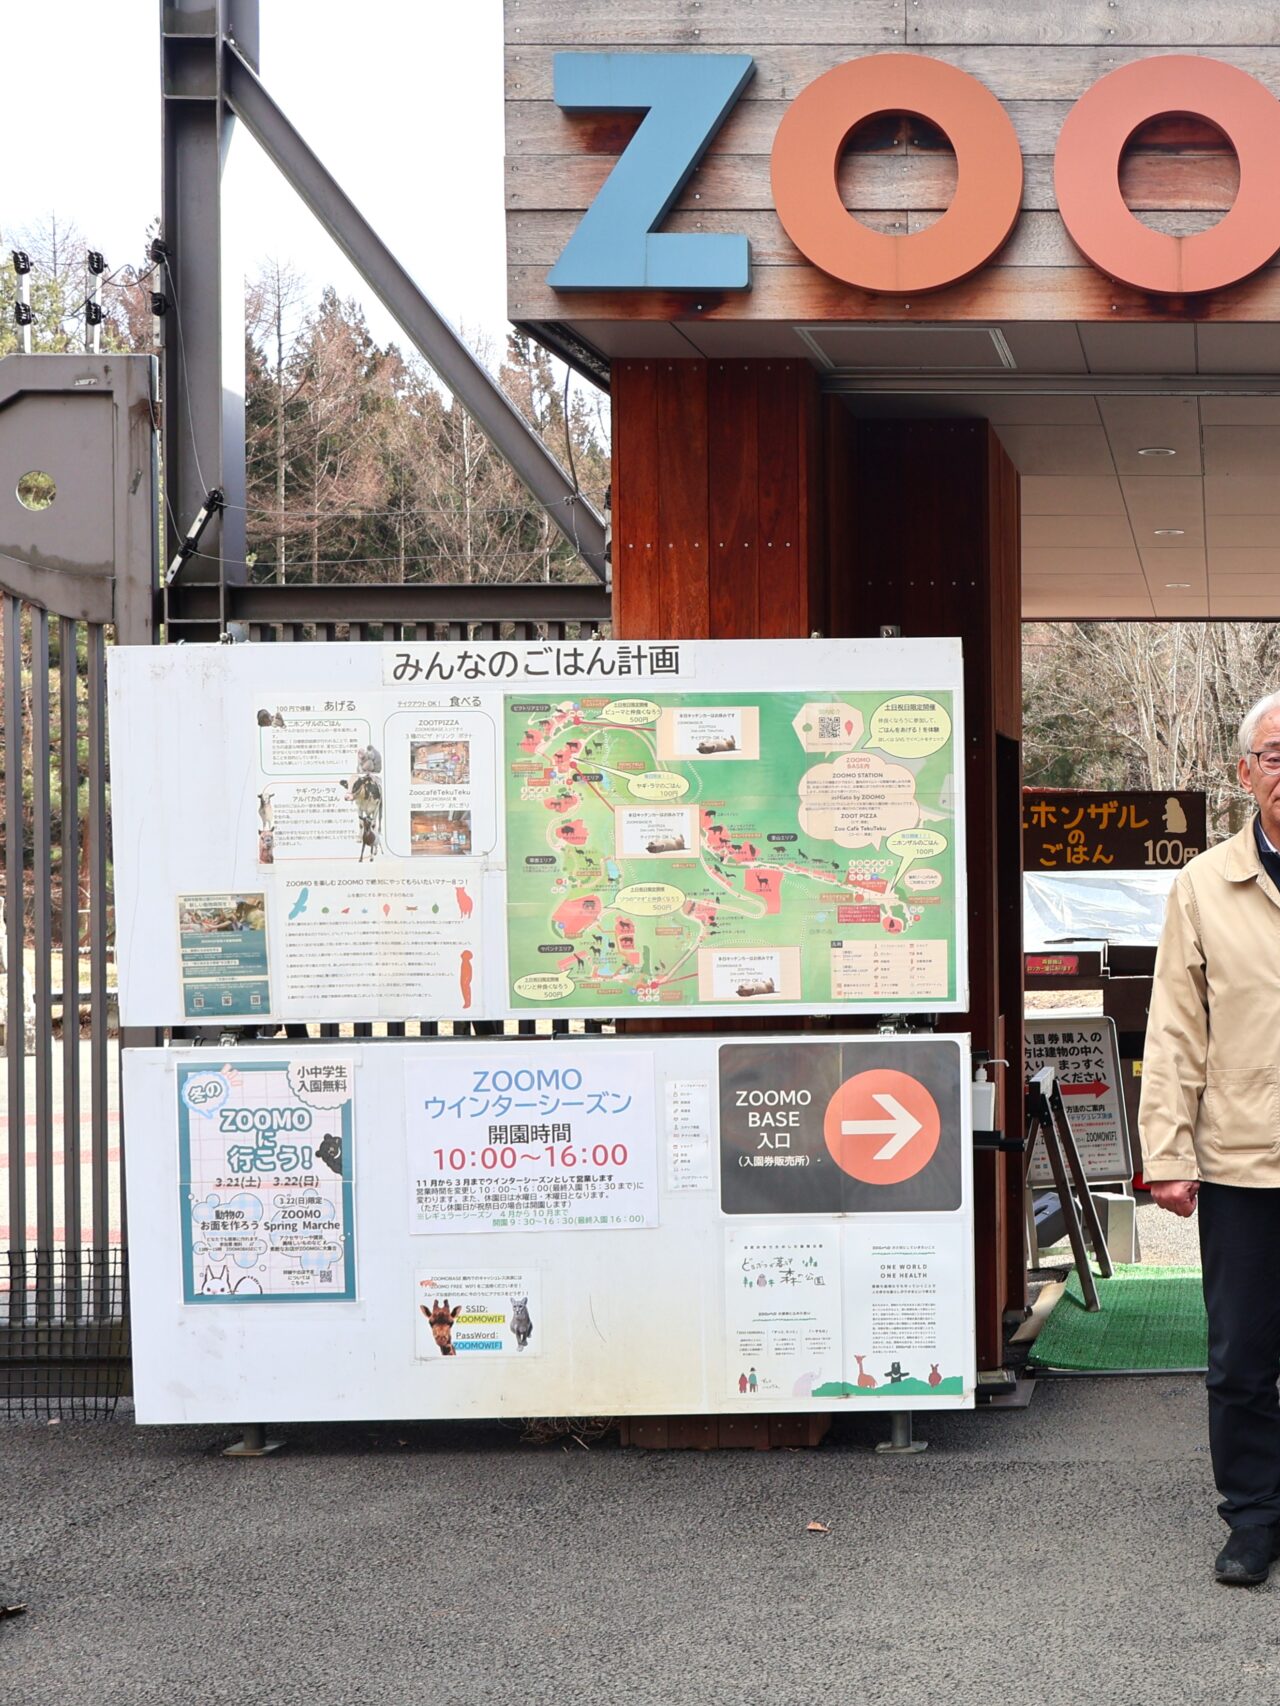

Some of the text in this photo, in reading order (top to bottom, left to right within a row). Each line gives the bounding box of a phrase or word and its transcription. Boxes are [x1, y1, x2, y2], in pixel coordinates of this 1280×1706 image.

[393, 645, 679, 681] みんなのごはん計画
[324, 700, 356, 711] あげる
[449, 695, 482, 707] 食べる
[1068, 829, 1085, 844] の
[1040, 844, 1114, 867] ごはん
[297, 1065, 347, 1078] 小中学生
[298, 1080, 347, 1092] 入園無料
[472, 1068, 582, 1093] ZOOMO
[188, 1081, 223, 1104] 冬の
[735, 1090, 812, 1106] ZOOMO
[424, 1091, 632, 1119] ウインターシーズン
[219, 1107, 312, 1132] ZOOMO
[748, 1111, 800, 1127] BASE
[256, 1130, 277, 1148] に
[488, 1123, 571, 1145] 開園時間
[756, 1132, 790, 1149] 入口
[227, 1145, 313, 1173] 行こう！
[738, 1155, 810, 1167] （入園券販売所）
[215, 1175, 319, 1188] 3.21(土) 3.22(日)
[215, 1210, 244, 1219] 動物の
[281, 1210, 321, 1219] ZOOMO
[200, 1221, 259, 1231] お面を作ろう
[264, 1221, 340, 1232] Spring Marche
[466, 1305, 488, 1313] SSID:
[456, 1315, 505, 1323] ZOOMOWIFI
[454, 1341, 502, 1350] ZOOMOWIFI
